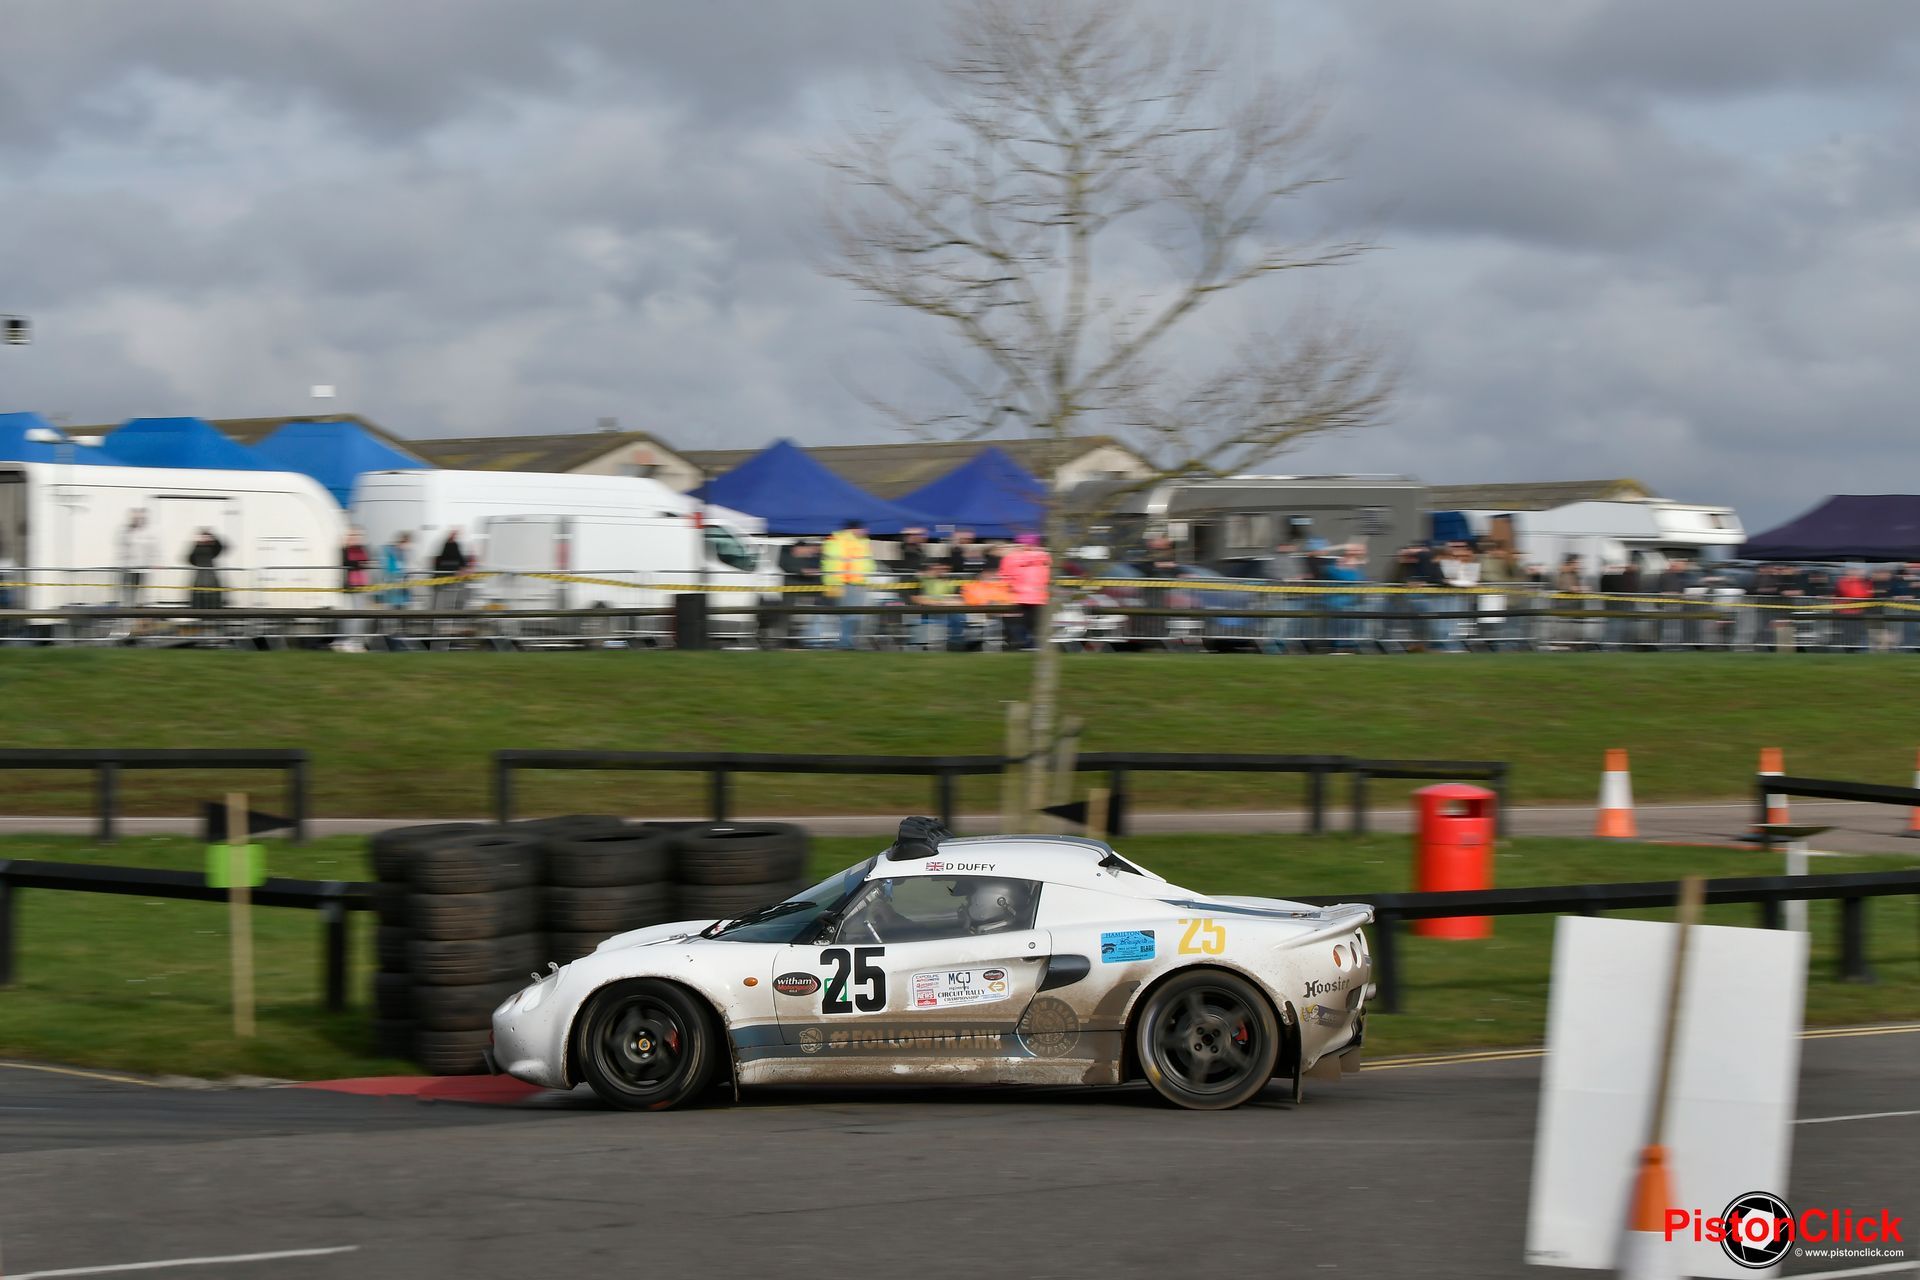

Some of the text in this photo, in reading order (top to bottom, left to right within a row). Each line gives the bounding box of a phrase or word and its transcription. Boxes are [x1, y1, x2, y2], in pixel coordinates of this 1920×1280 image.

[945, 862, 996, 871] D DUFFY
[1177, 918, 1226, 955] 25
[777, 976, 812, 985] witham
[819, 946, 887, 1014] 25
[1303, 976, 1350, 998] Hoosier
[937, 990, 964, 998] CIRCUIT
